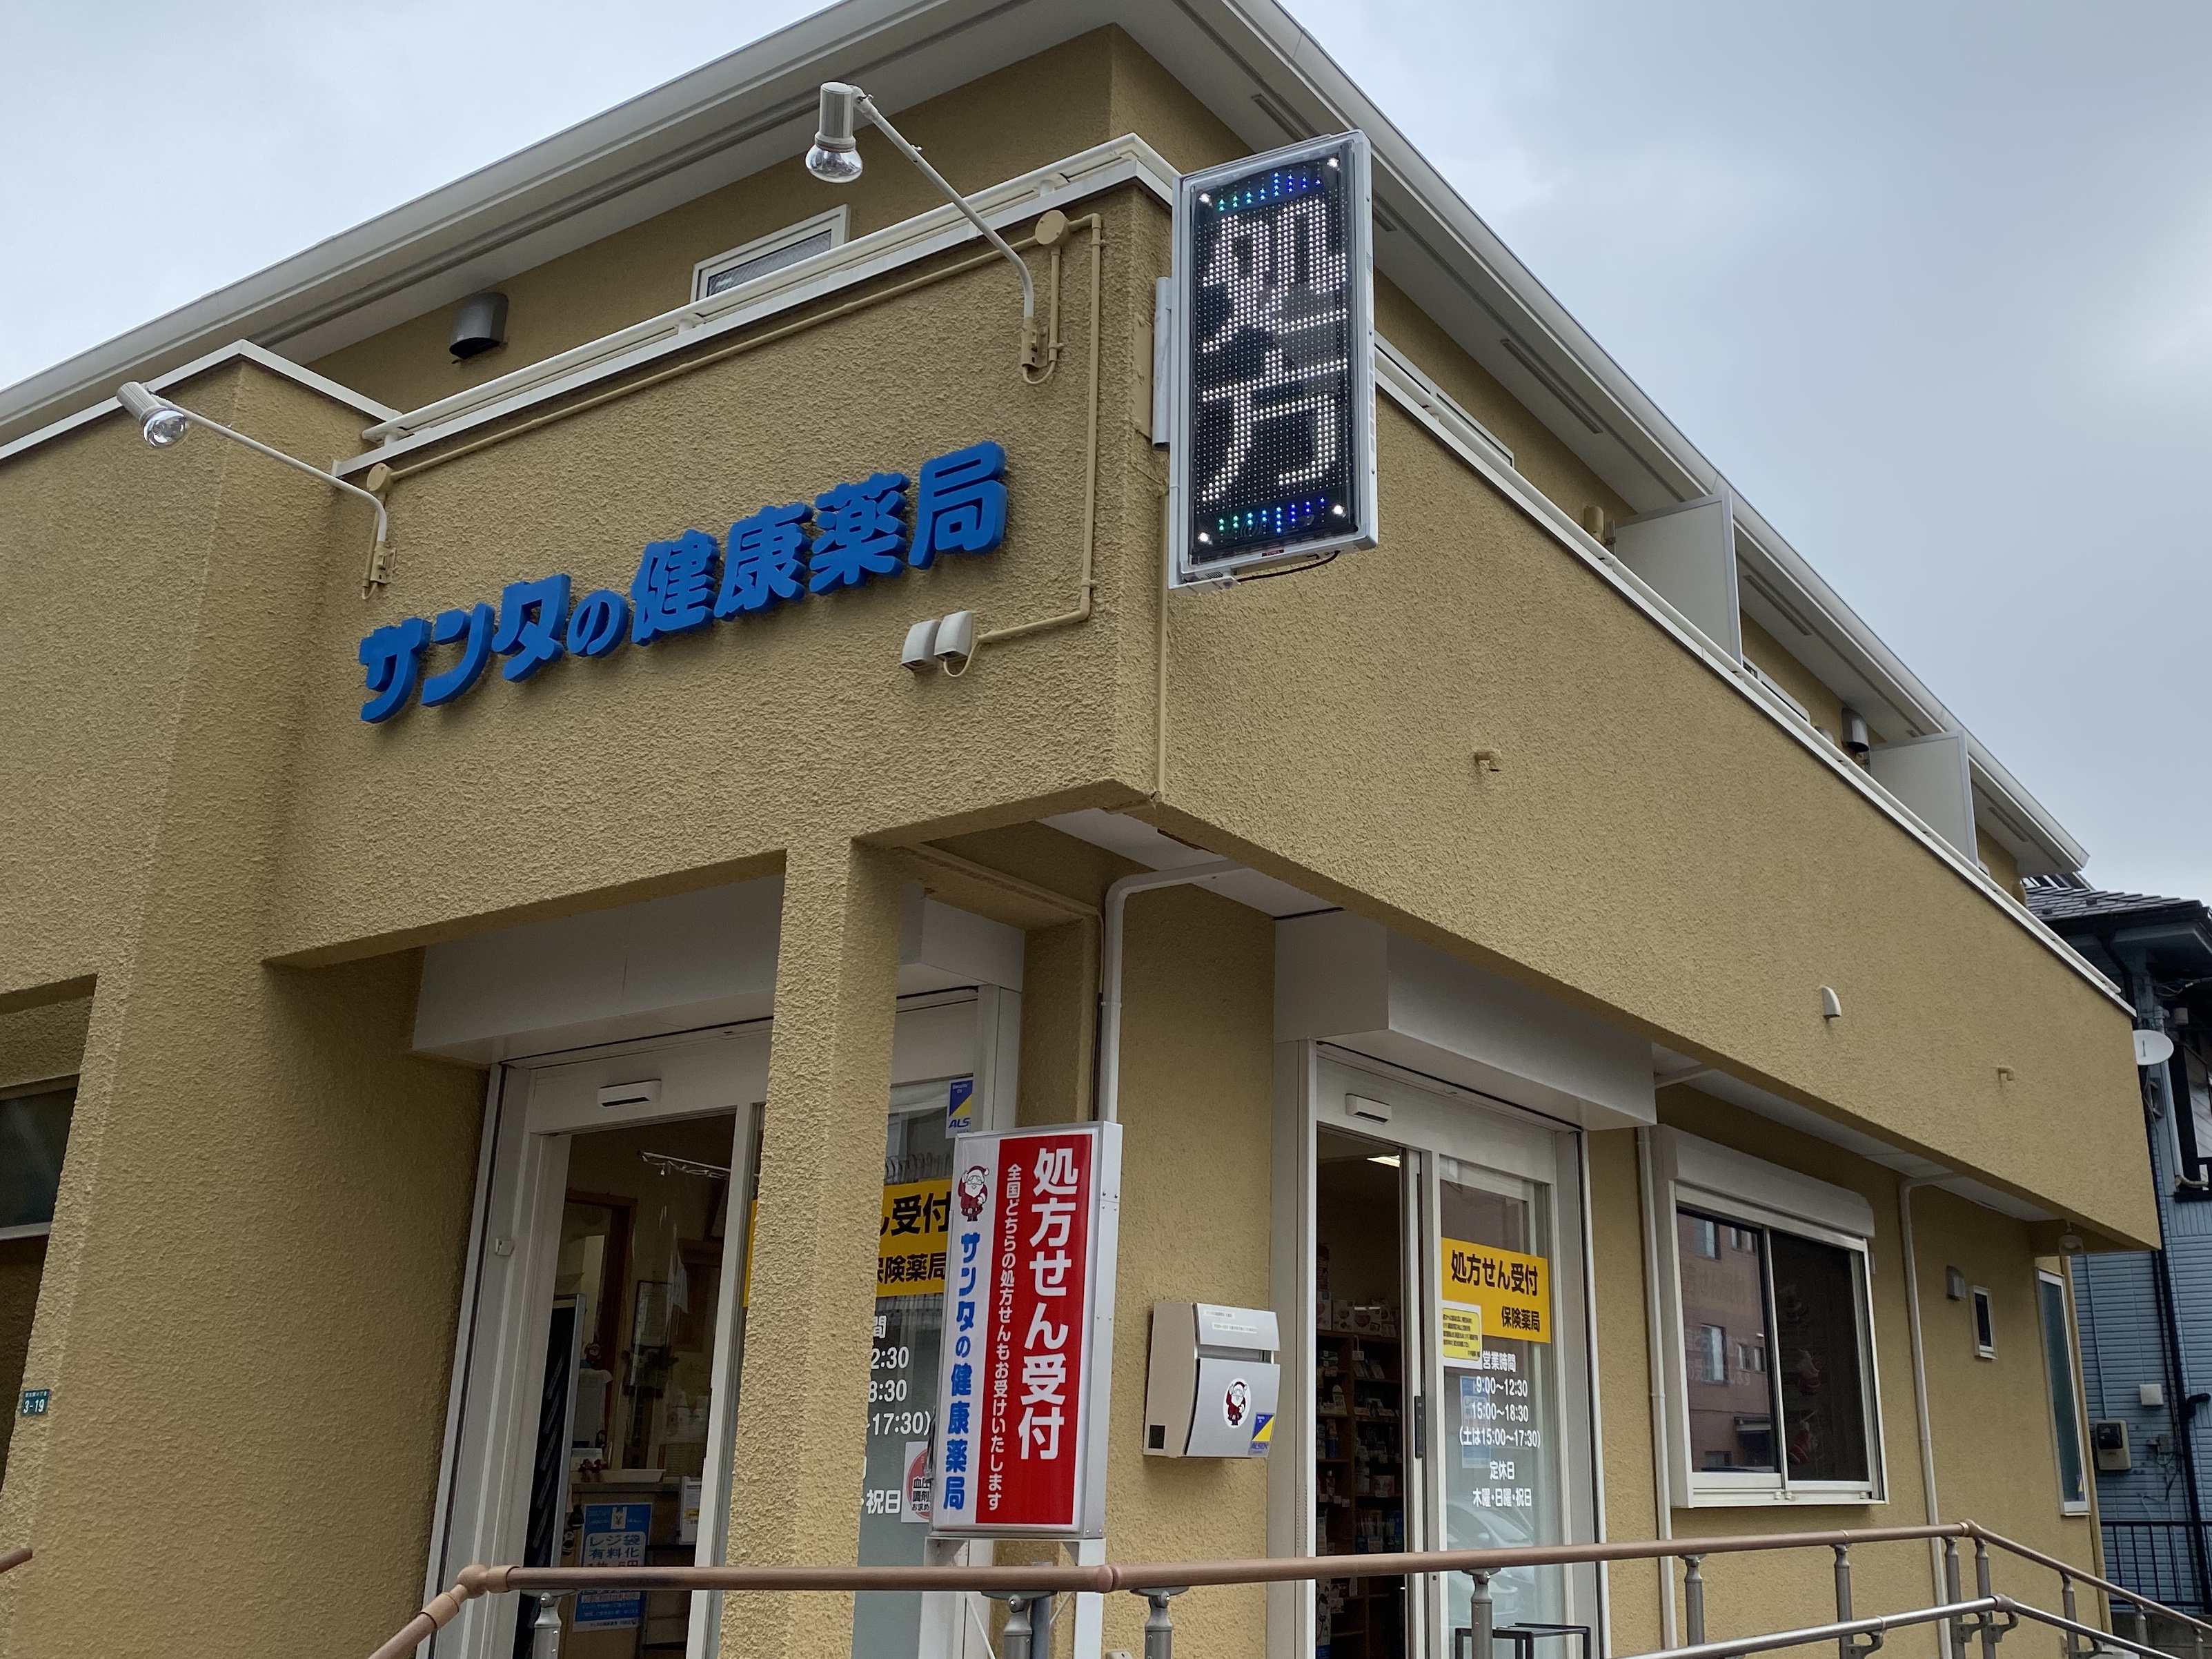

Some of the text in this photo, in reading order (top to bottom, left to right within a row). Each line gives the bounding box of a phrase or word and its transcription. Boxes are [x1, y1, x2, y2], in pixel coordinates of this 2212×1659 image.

[1201, 198, 1348, 502] 処方
[358, 440, 1007, 723] サンタの健康薬局
[949, 1117, 971, 1128] ALS
[880, 1191, 951, 1237] 受付
[1451, 1250, 1538, 1296] 処方せん受付
[1018, 1148, 1078, 1460] 処方せん受付
[1501, 1306, 1540, 1333] 保険薬局
[987, 1164, 1022, 1511] 全国どちらの処方せんもお受けいたします
[943, 1232, 980, 1509] サンタの健康薬局
[1483, 1350, 1517, 1373] 営業時間
[23, 1399, 45, 1413] 3-19
[1490, 1460, 1515, 1480] 定休日
[1472, 1487, 1532, 1508] 木曜・日曜・祝日
[589, 1547, 640, 1560] 有料化
[590, 1534, 641, 1547] レジ袋
